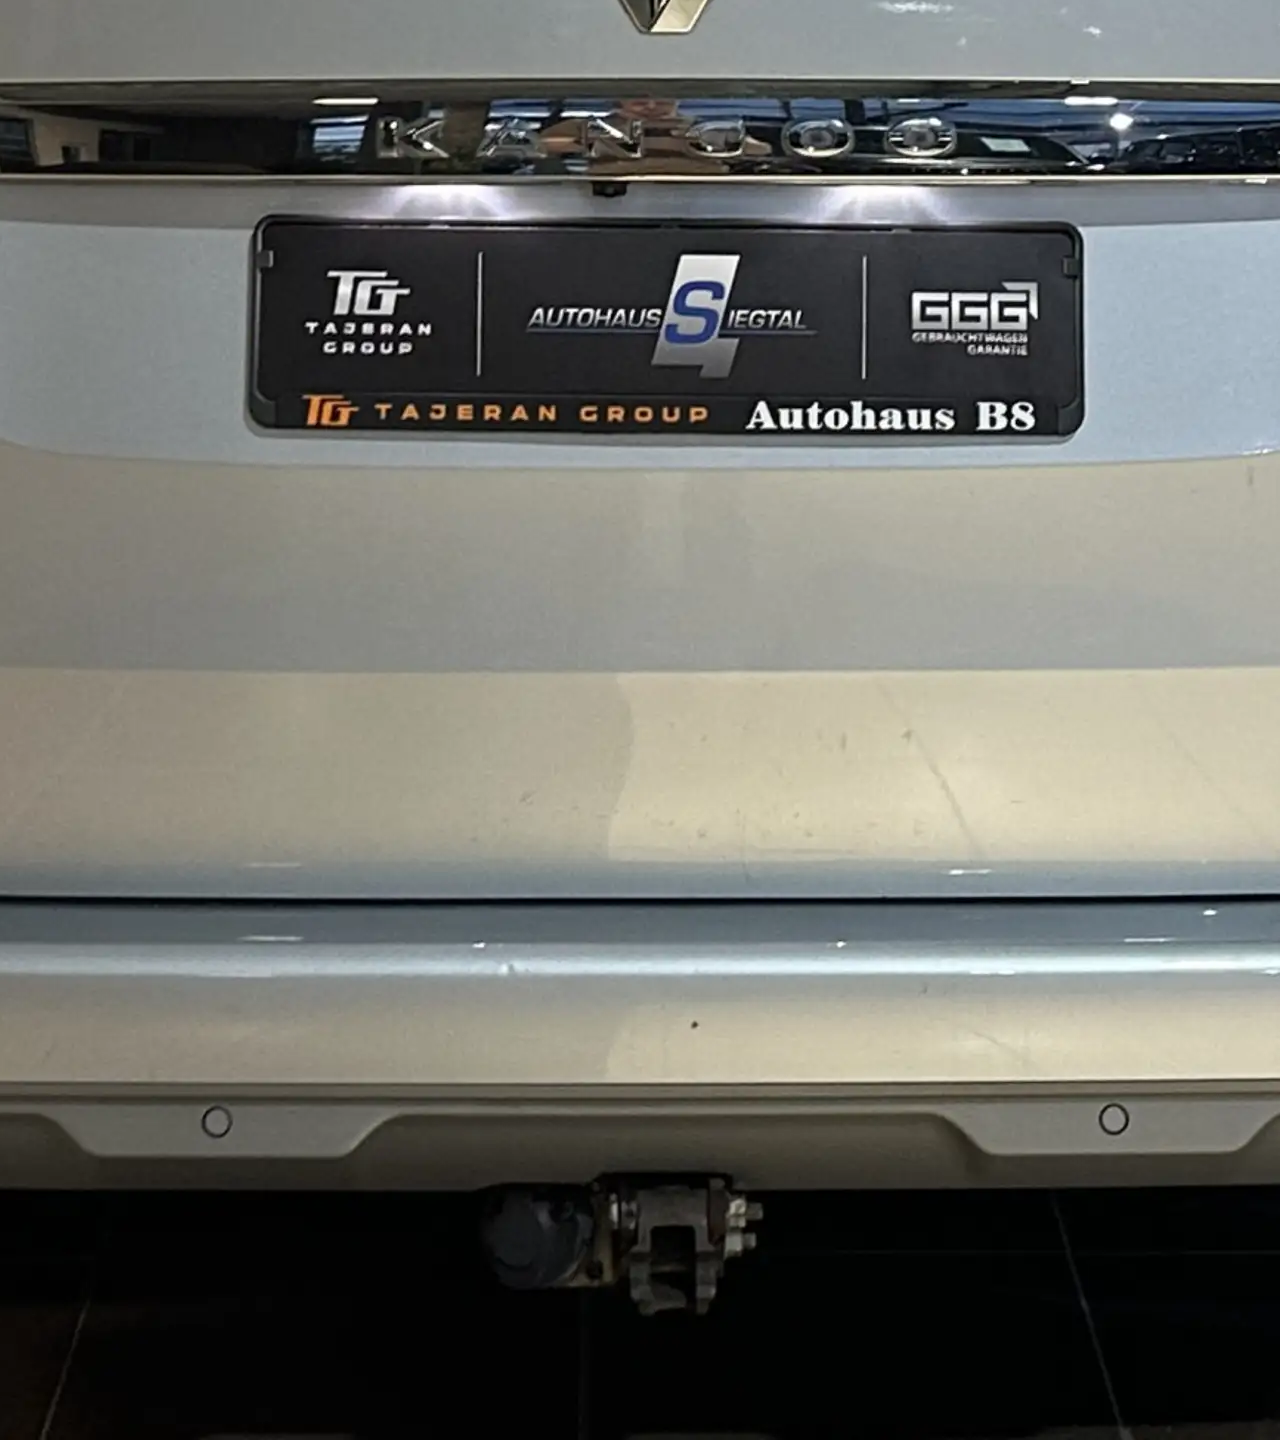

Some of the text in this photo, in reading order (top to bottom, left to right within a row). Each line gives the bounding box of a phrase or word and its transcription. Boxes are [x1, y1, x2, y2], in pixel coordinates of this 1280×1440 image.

[376, 115, 958, 159] KANGOO
[528, 307, 662, 329] AUTOHAUS
[911, 291, 1028, 331] GGG
[303, 321, 433, 336] TAJERAN
[911, 331, 1028, 344] GEBRAUCHTWAGEN
[322, 340, 414, 355] GROUP
[966, 343, 1028, 357] GARANTIE
[374, 402, 558, 422] TAJERAN
[578, 405, 710, 424] GROUP
[745, 399, 1037, 432] Autohaus B8
